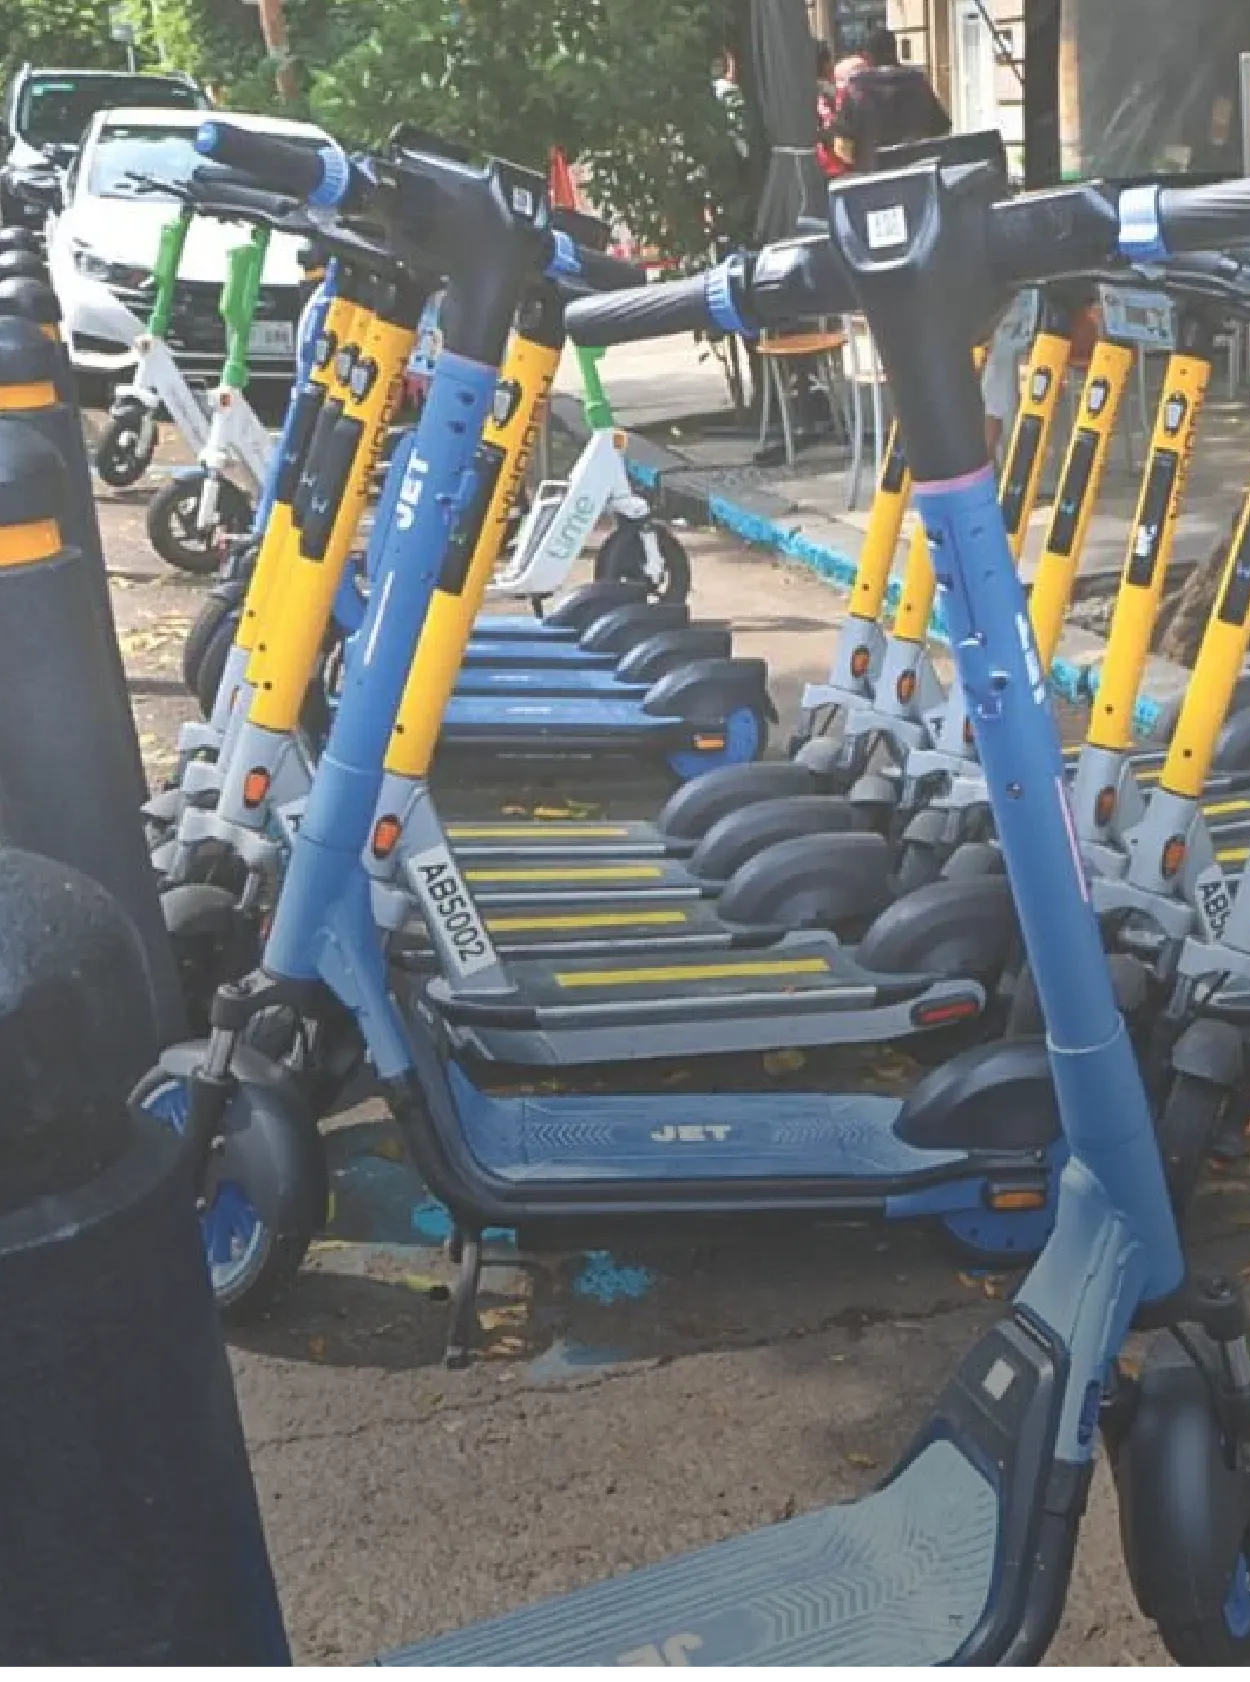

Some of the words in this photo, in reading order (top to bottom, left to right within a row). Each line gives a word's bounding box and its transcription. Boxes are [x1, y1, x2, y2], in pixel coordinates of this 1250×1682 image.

[396, 448, 429, 531] JET
[546, 494, 596, 558] Lime
[416, 863, 486, 962] AB5002
[650, 1123, 732, 1142] JET
